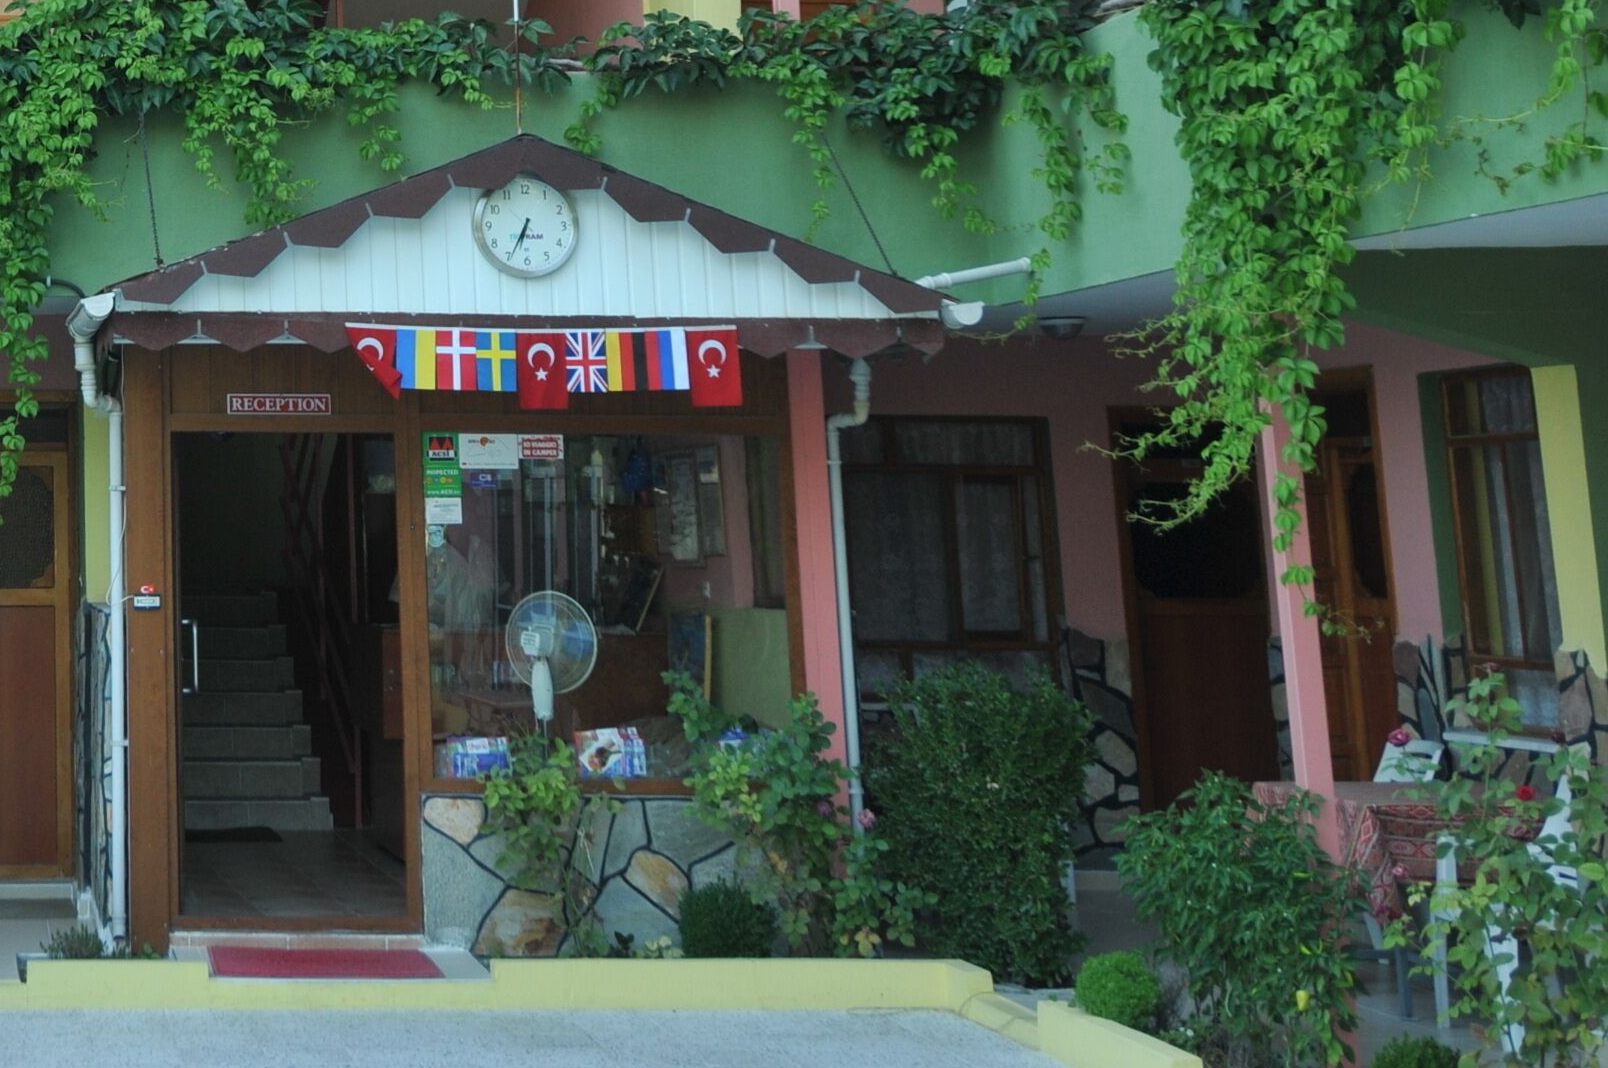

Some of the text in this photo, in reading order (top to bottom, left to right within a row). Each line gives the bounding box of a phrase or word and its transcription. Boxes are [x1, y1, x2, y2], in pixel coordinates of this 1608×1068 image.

[520, 184, 530, 195] 12
[503, 190, 511, 201] 11
[490, 204, 500, 215] 10
[556, 204, 563, 215] 2
[485, 221, 493, 231] 9
[560, 221, 567, 231] 3
[490, 238, 498, 249] 8
[556, 238, 563, 248] 4
[524, 256, 531, 266] 6
[543, 251, 550, 261] 5
[232, 397, 327, 412] RECEPTION
